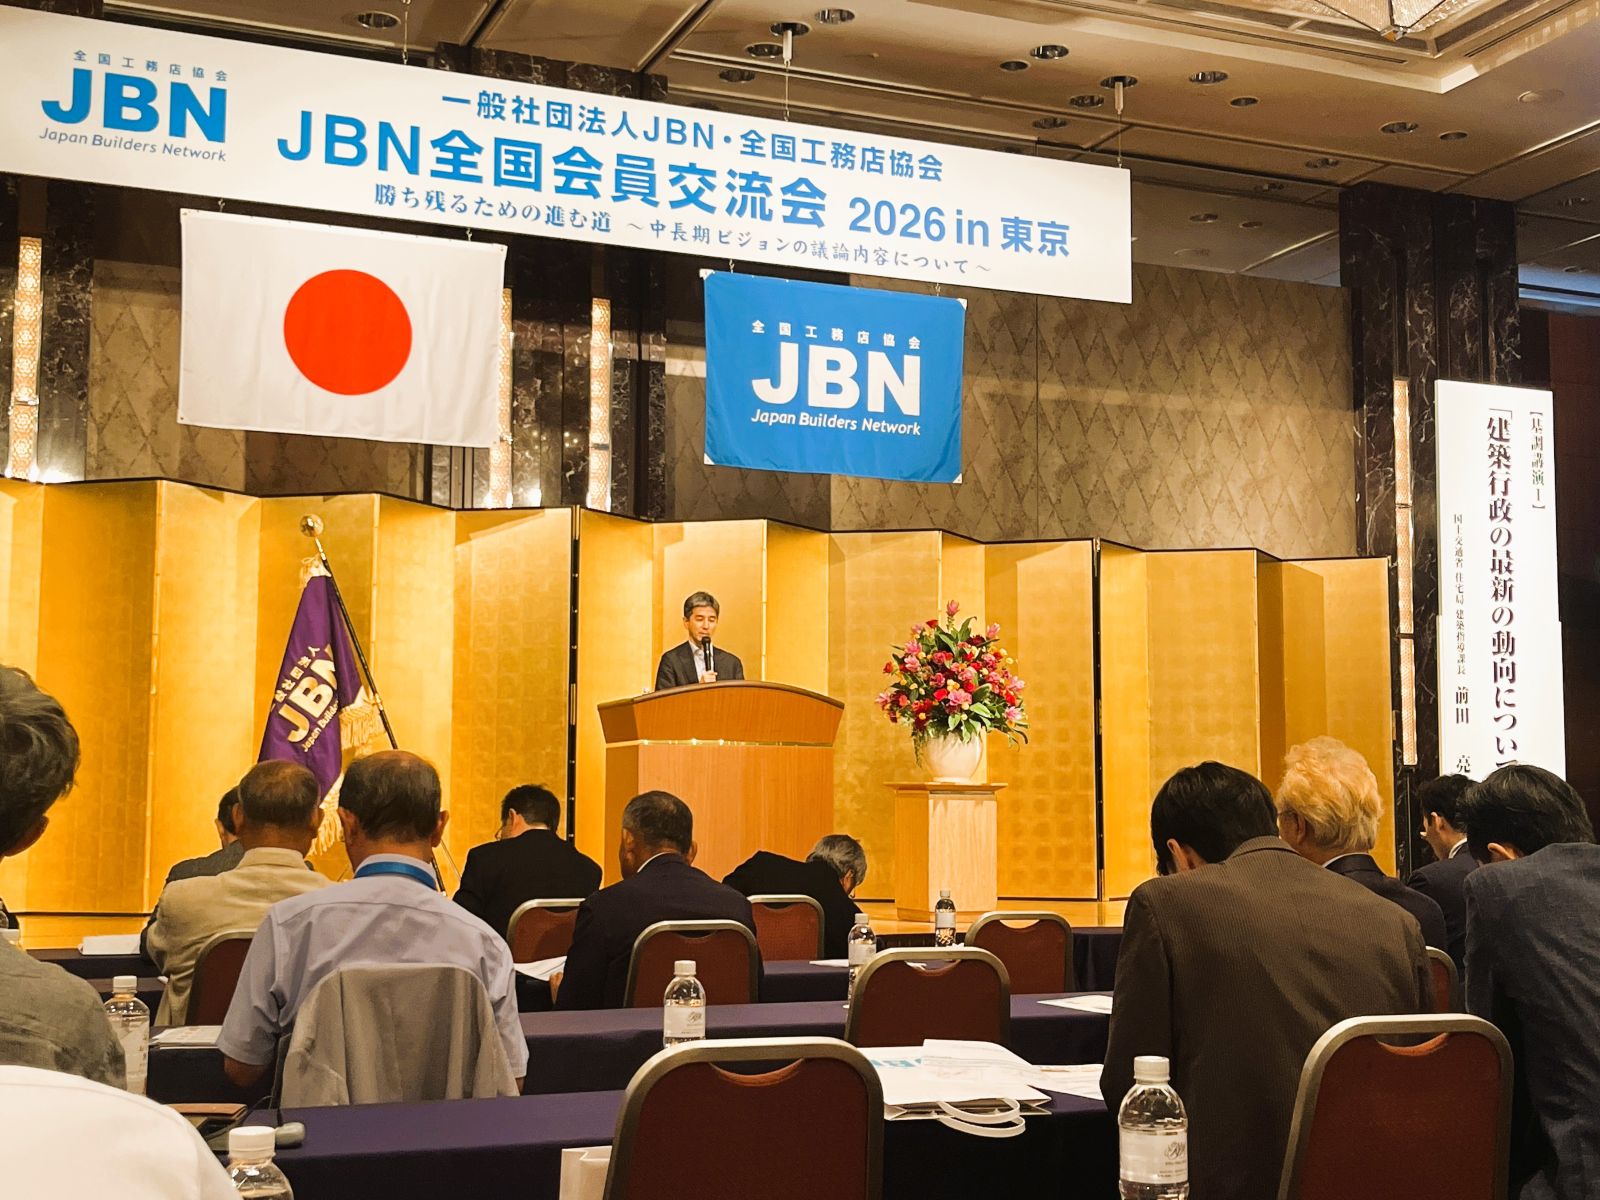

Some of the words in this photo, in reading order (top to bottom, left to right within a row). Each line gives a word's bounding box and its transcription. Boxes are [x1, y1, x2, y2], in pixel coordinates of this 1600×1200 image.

[73, 50, 227, 82] 全国工務店協会
[41, 68, 227, 143] JBN
[39, 127, 88, 144] Japan
[91, 134, 157, 153] Builders
[162, 143, 226, 162] Network
[442, 91, 942, 181] 一般社団法人JBN・全国工務店協会
[277, 109, 827, 228] JBN全国会員交流会
[848, 196, 946, 242] 2026
[955, 209, 990, 247] in
[1000, 216, 1070, 257] 東京
[374, 183, 612, 233] 勝ち残るための進む道
[752, 320, 921, 350] 全国工務店協会
[751, 341, 921, 416] JBN
[751, 409, 796, 426] Japan
[799, 412, 857, 431] Builders
[861, 418, 921, 435] Network
[302, 727, 322, 753] Japan
